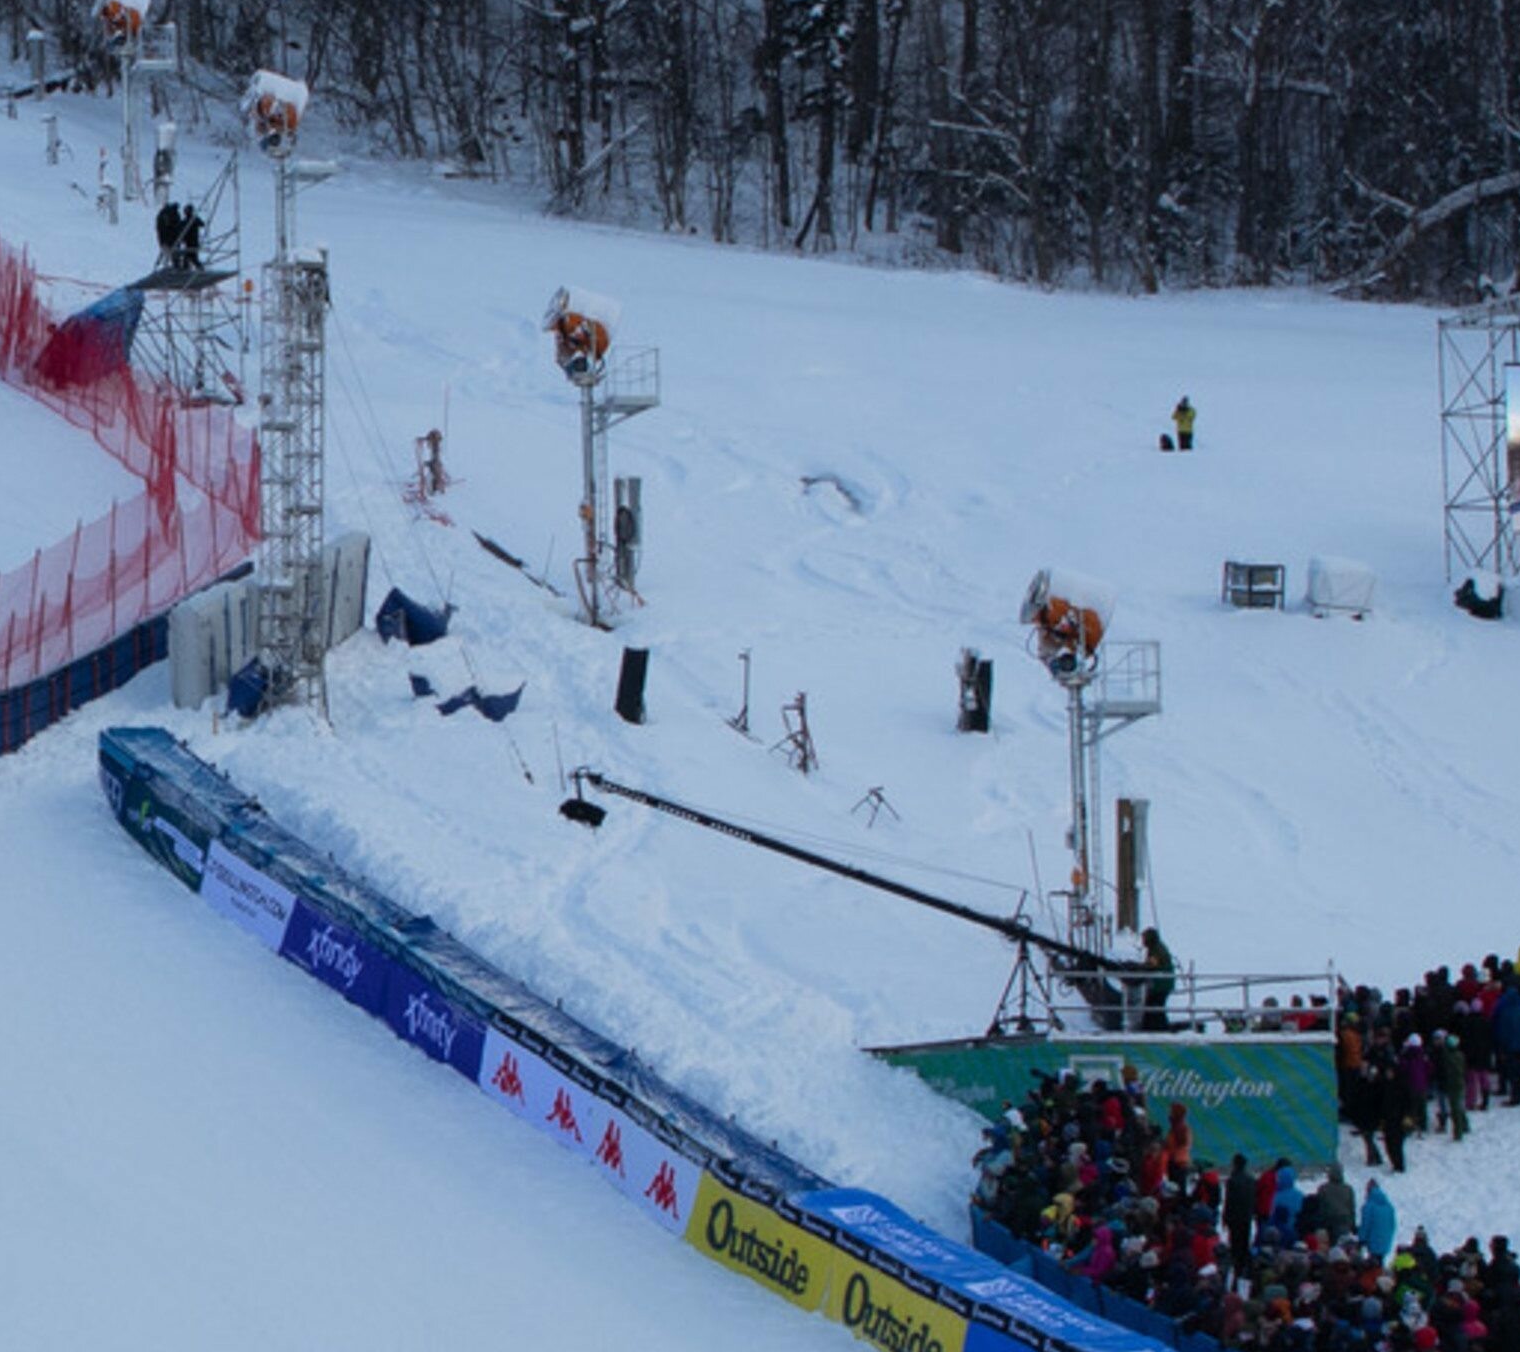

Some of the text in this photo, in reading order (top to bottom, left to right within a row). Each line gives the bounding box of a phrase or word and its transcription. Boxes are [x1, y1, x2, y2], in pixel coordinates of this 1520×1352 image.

[306, 926, 364, 987] xfinity
[404, 992, 458, 1058] xfinity
[1139, 1066, 1275, 1107] Killington
[705, 1199, 809, 1296] Outside
